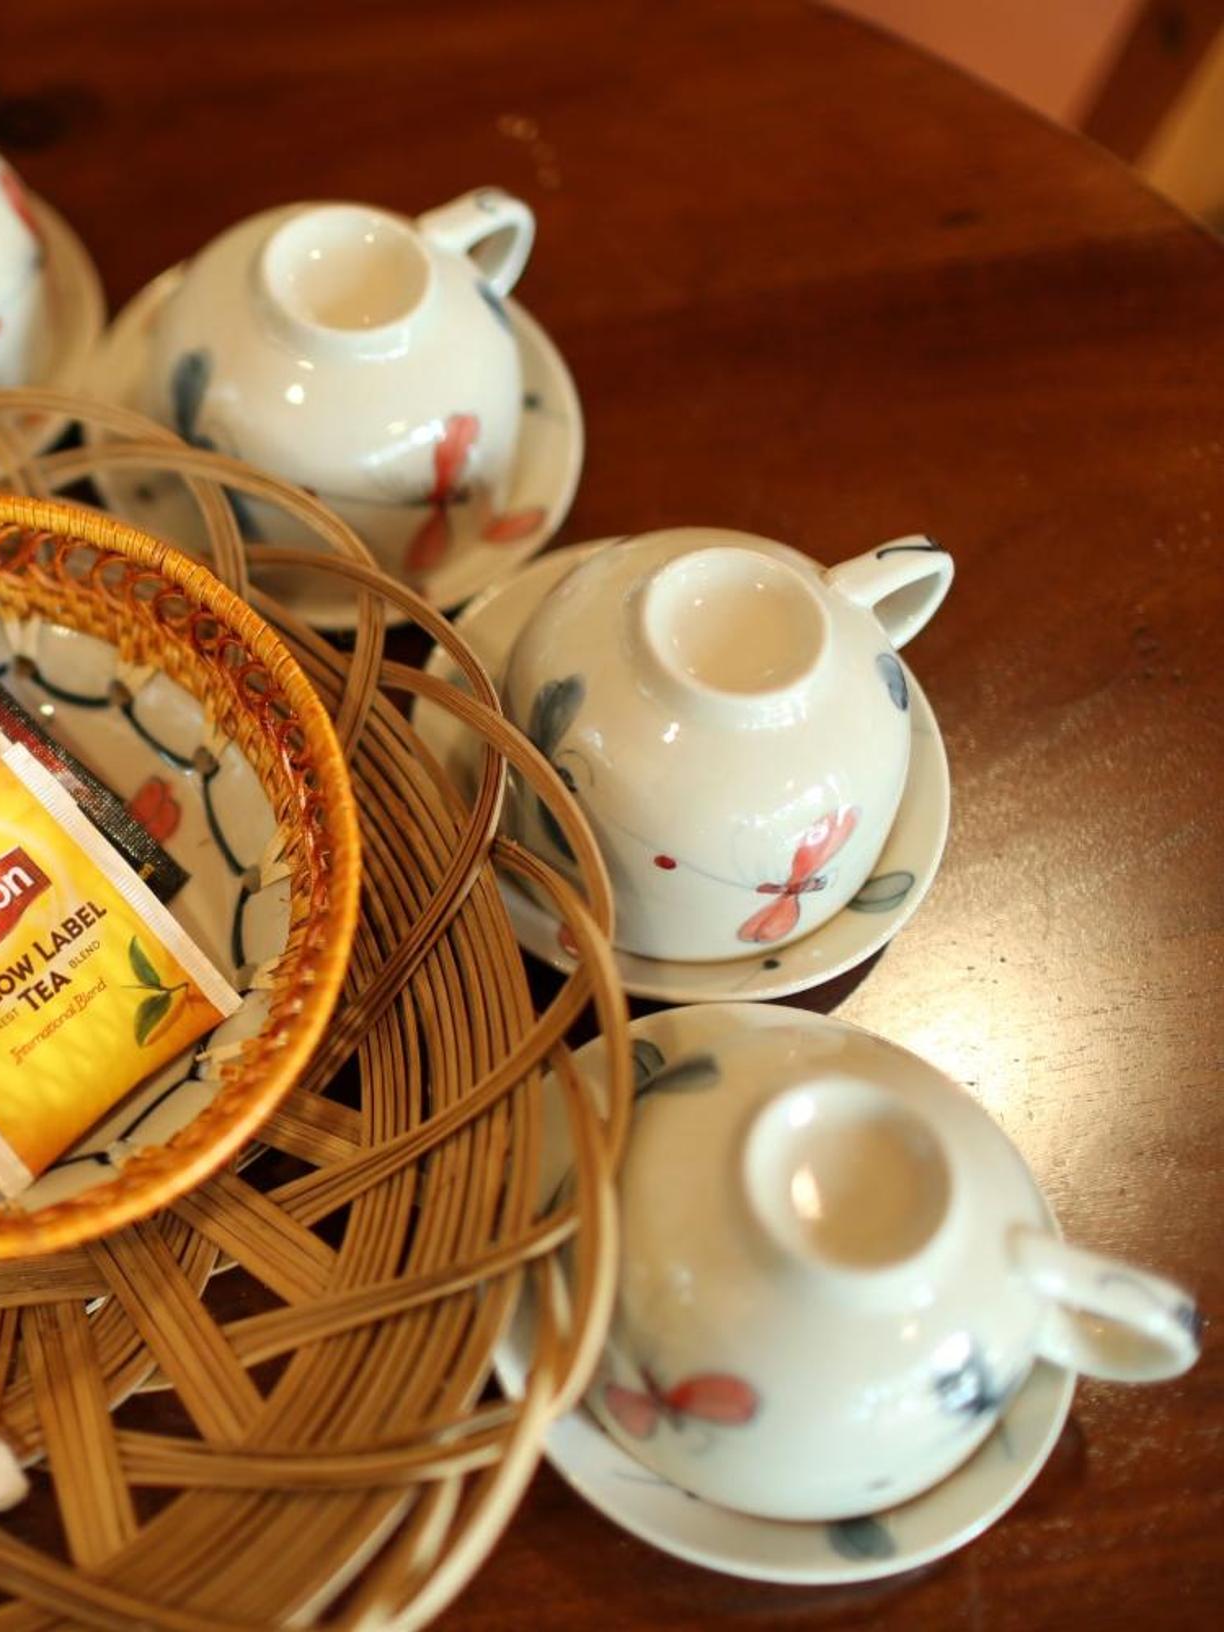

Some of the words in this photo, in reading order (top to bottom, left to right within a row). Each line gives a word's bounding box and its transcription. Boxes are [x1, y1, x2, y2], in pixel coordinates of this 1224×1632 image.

[32, 901, 108, 963] LABEL
[16, 970, 73, 1013] TEA
[68, 939, 101, 969] BLEND
[9, 1003, 78, 1066] International
[72, 975, 108, 1013] Blend
